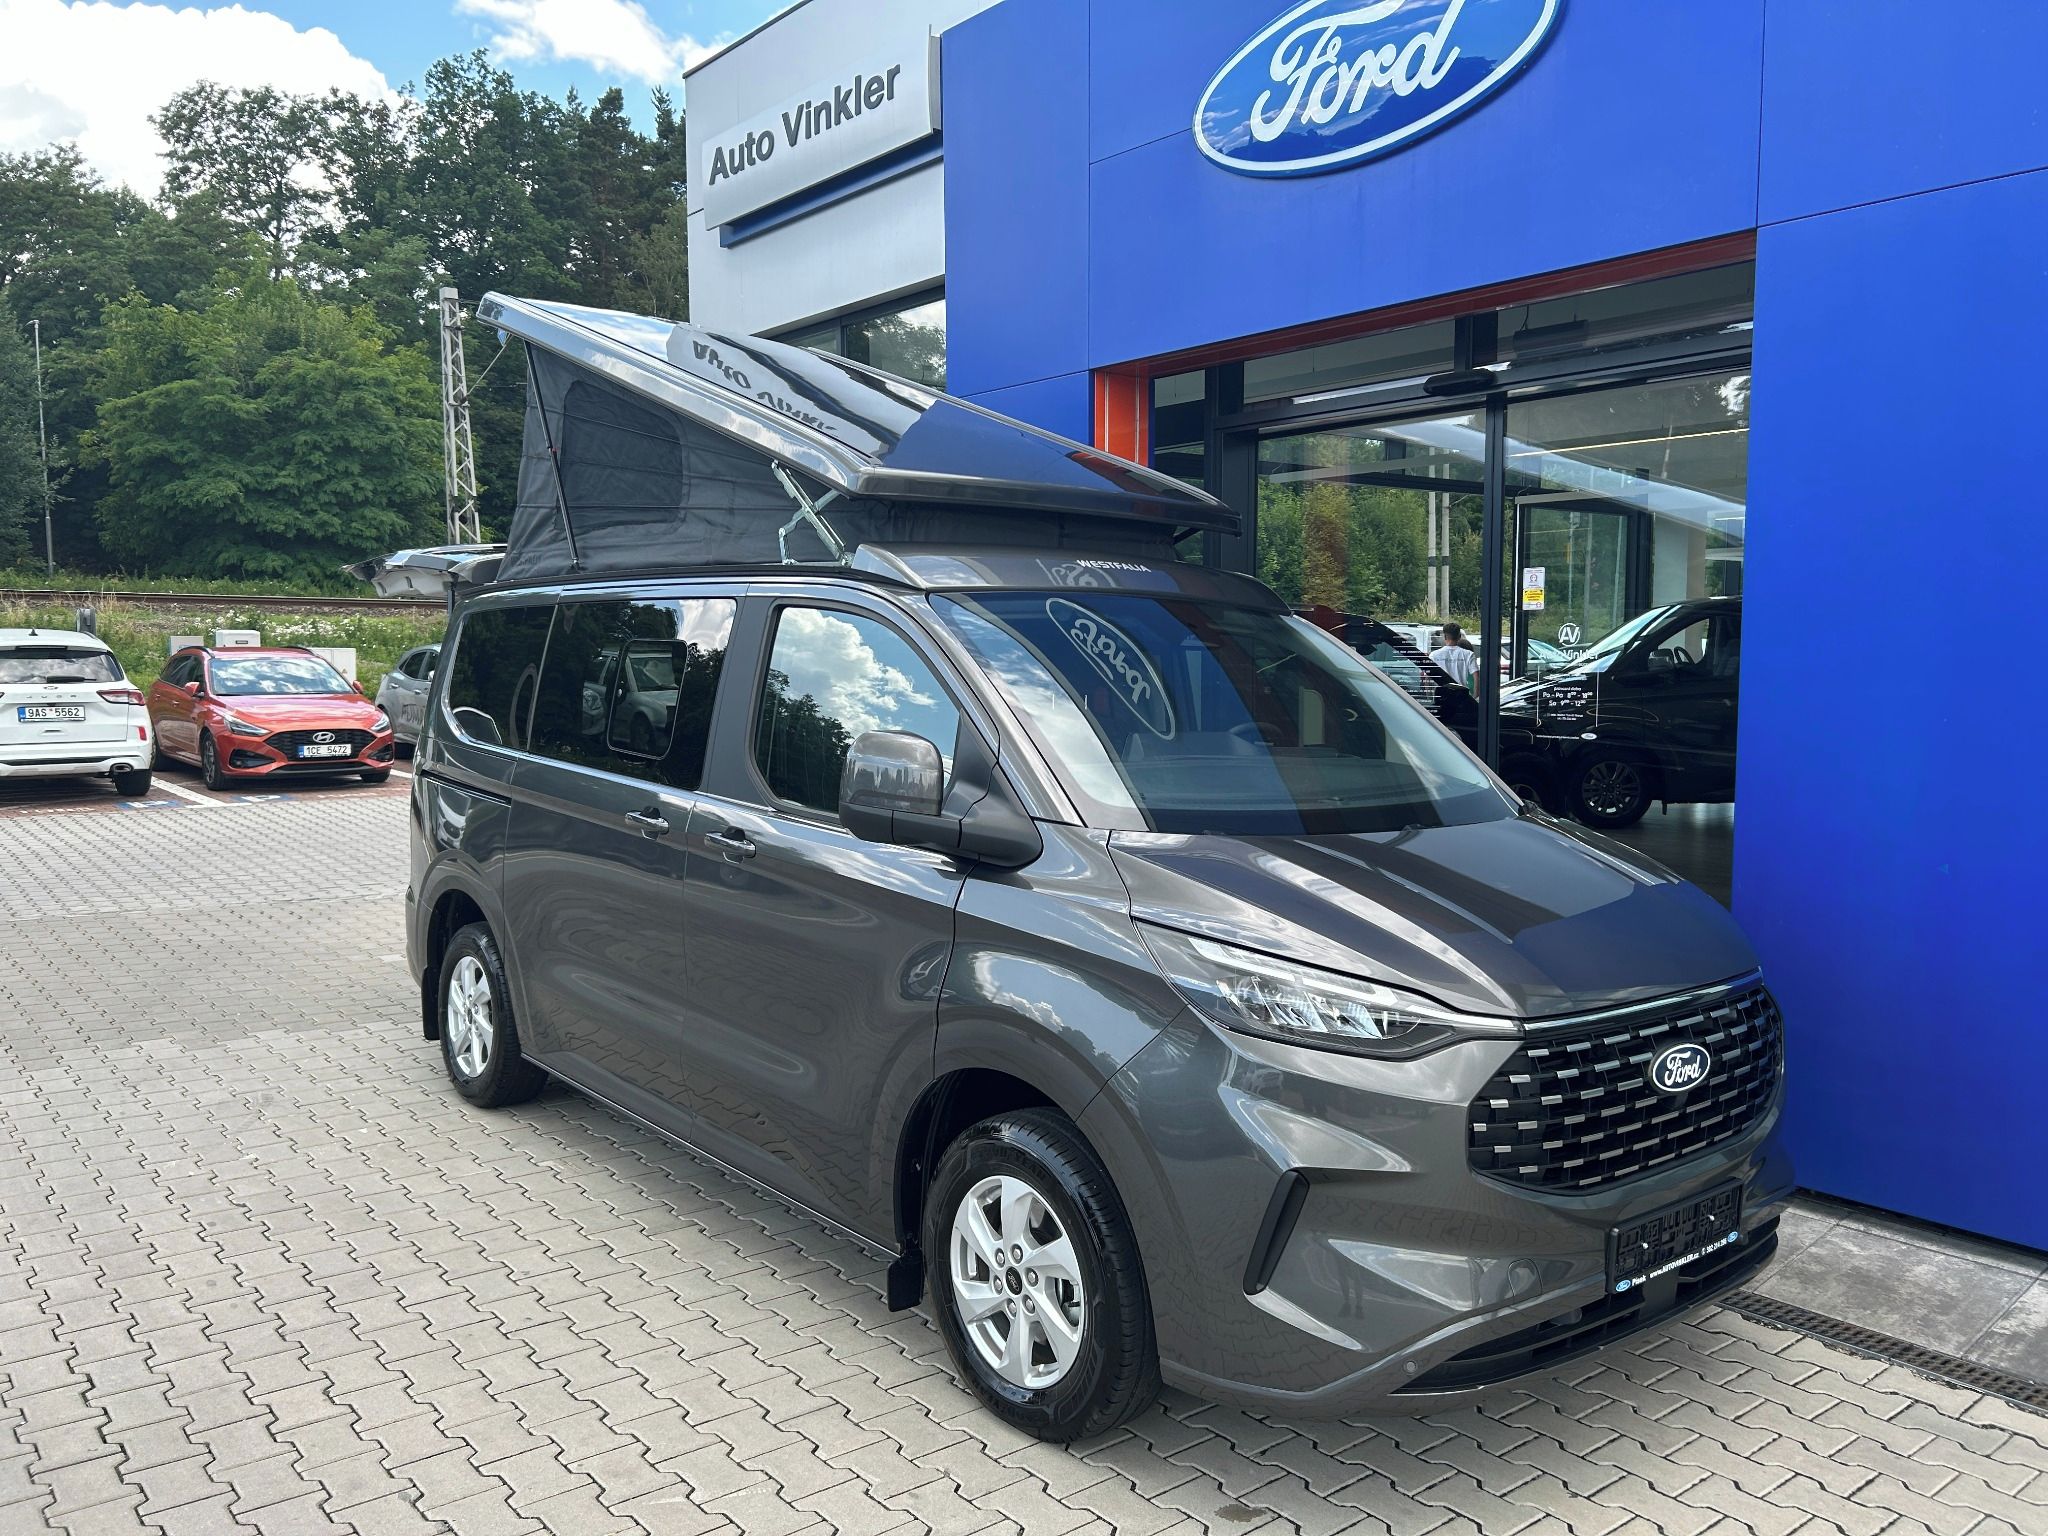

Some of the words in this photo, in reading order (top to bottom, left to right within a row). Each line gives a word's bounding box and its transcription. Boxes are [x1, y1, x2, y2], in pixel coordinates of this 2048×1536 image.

[1250, 0, 1461, 142] Ford
[709, 130, 775, 186] Auto
[781, 64, 901, 148] Vinkler
[1076, 559, 1152, 573] WESTFALIA
[27, 708, 47, 718] 9AS
[54, 707, 80, 717] 5562
[306, 746, 321, 755] 1CE
[327, 745, 348, 754] 5472
[1664, 1050, 1702, 1087] Ford
